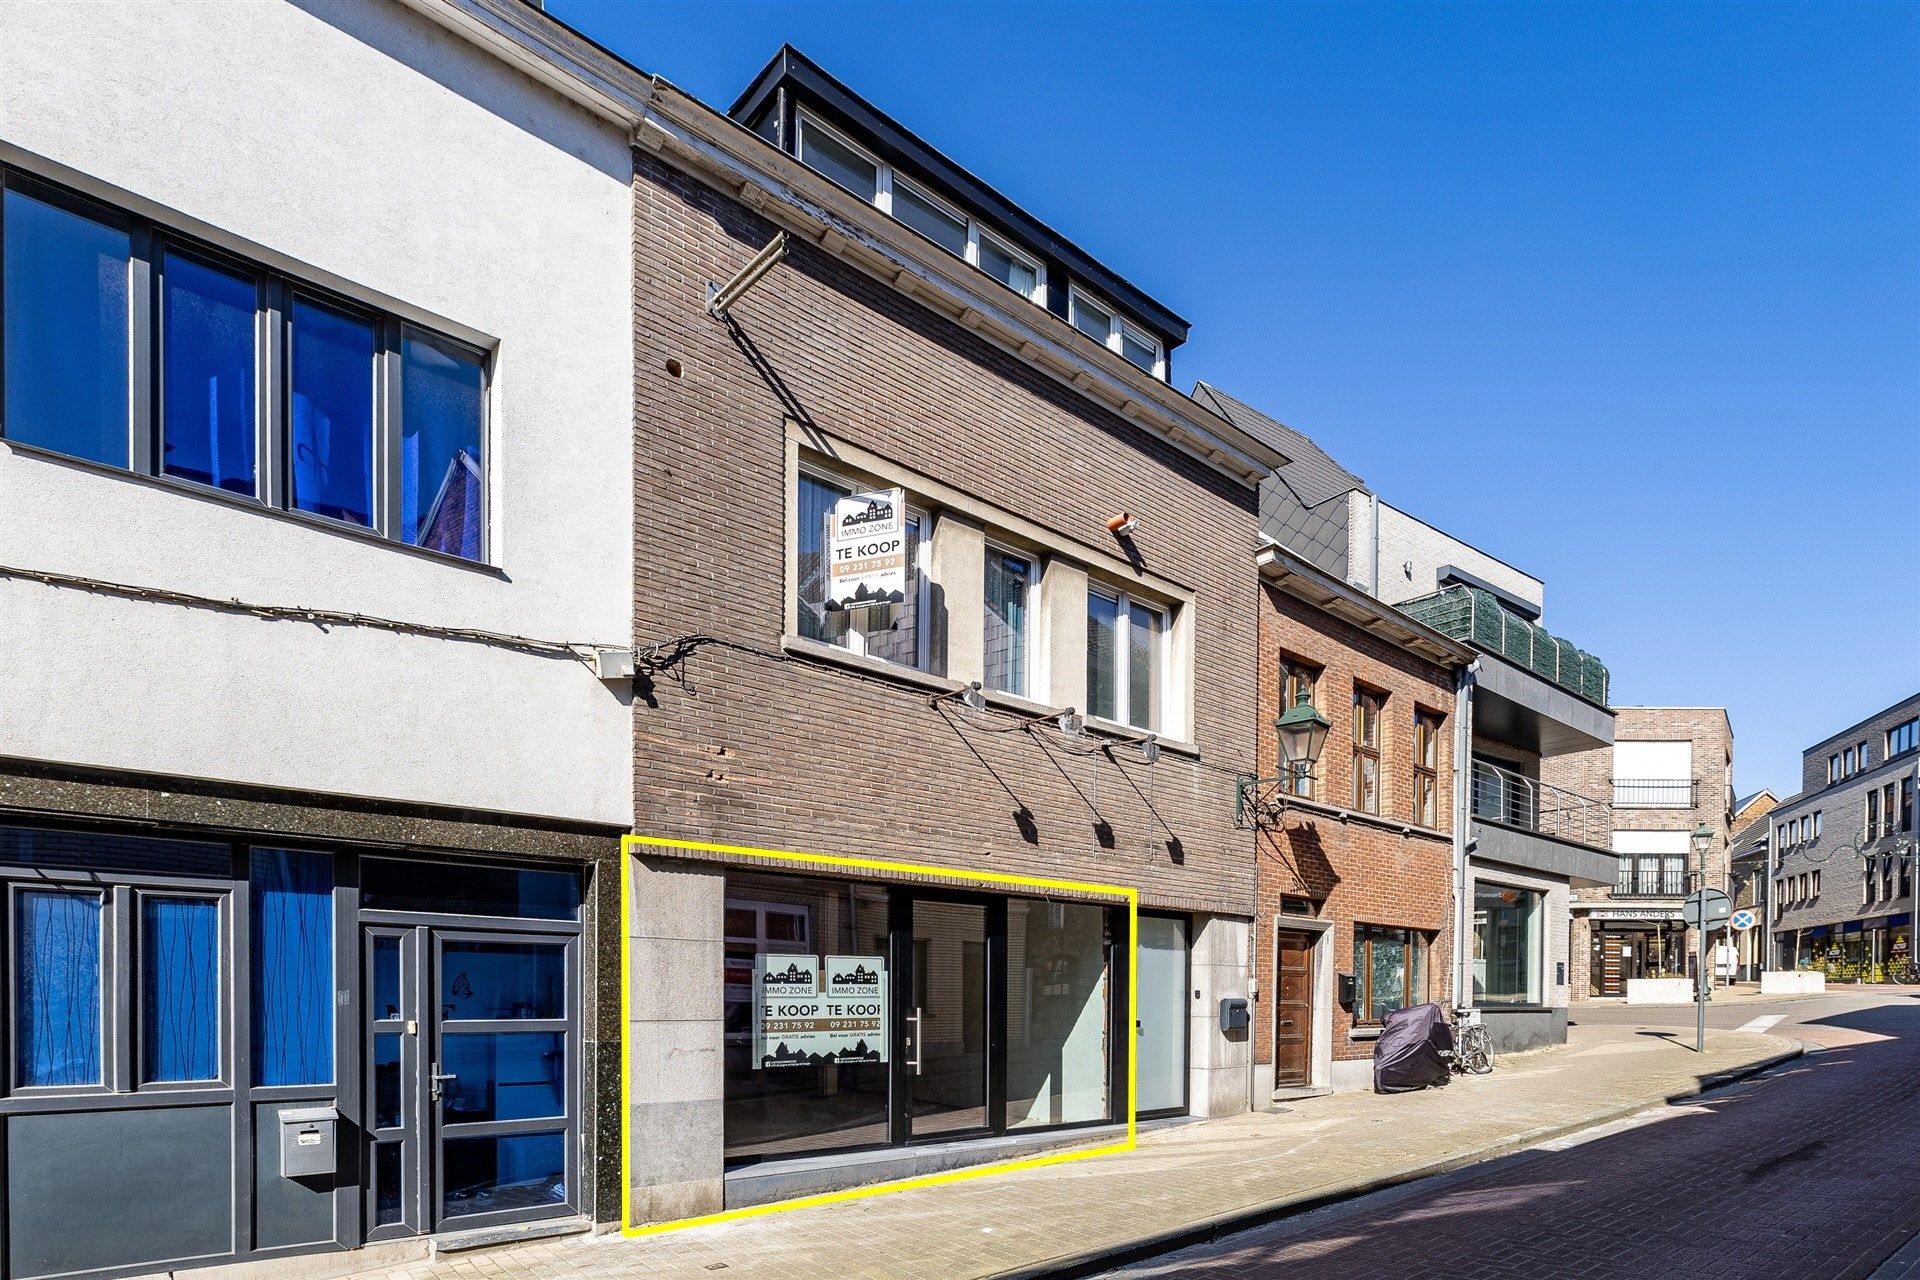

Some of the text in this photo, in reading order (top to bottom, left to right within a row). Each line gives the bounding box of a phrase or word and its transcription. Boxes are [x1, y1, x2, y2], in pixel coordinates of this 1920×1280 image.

[841, 522, 894, 537] IMMO ZONE
[836, 540, 900, 560] TE KOOP
[839, 557, 896, 574] 09 231 75 92
[1612, 910, 1676, 918] HANS ANDERS
[762, 986, 813, 994] IMMO ZONE
[831, 986, 879, 994] IMMO ZONE
[778, 1005, 819, 1016] KOOP
[826, 1004, 842, 1016] TE
[773, 1022, 788, 1030] 231
[804, 1021, 815, 1029] 92
[871, 1020, 880, 1028] 92
